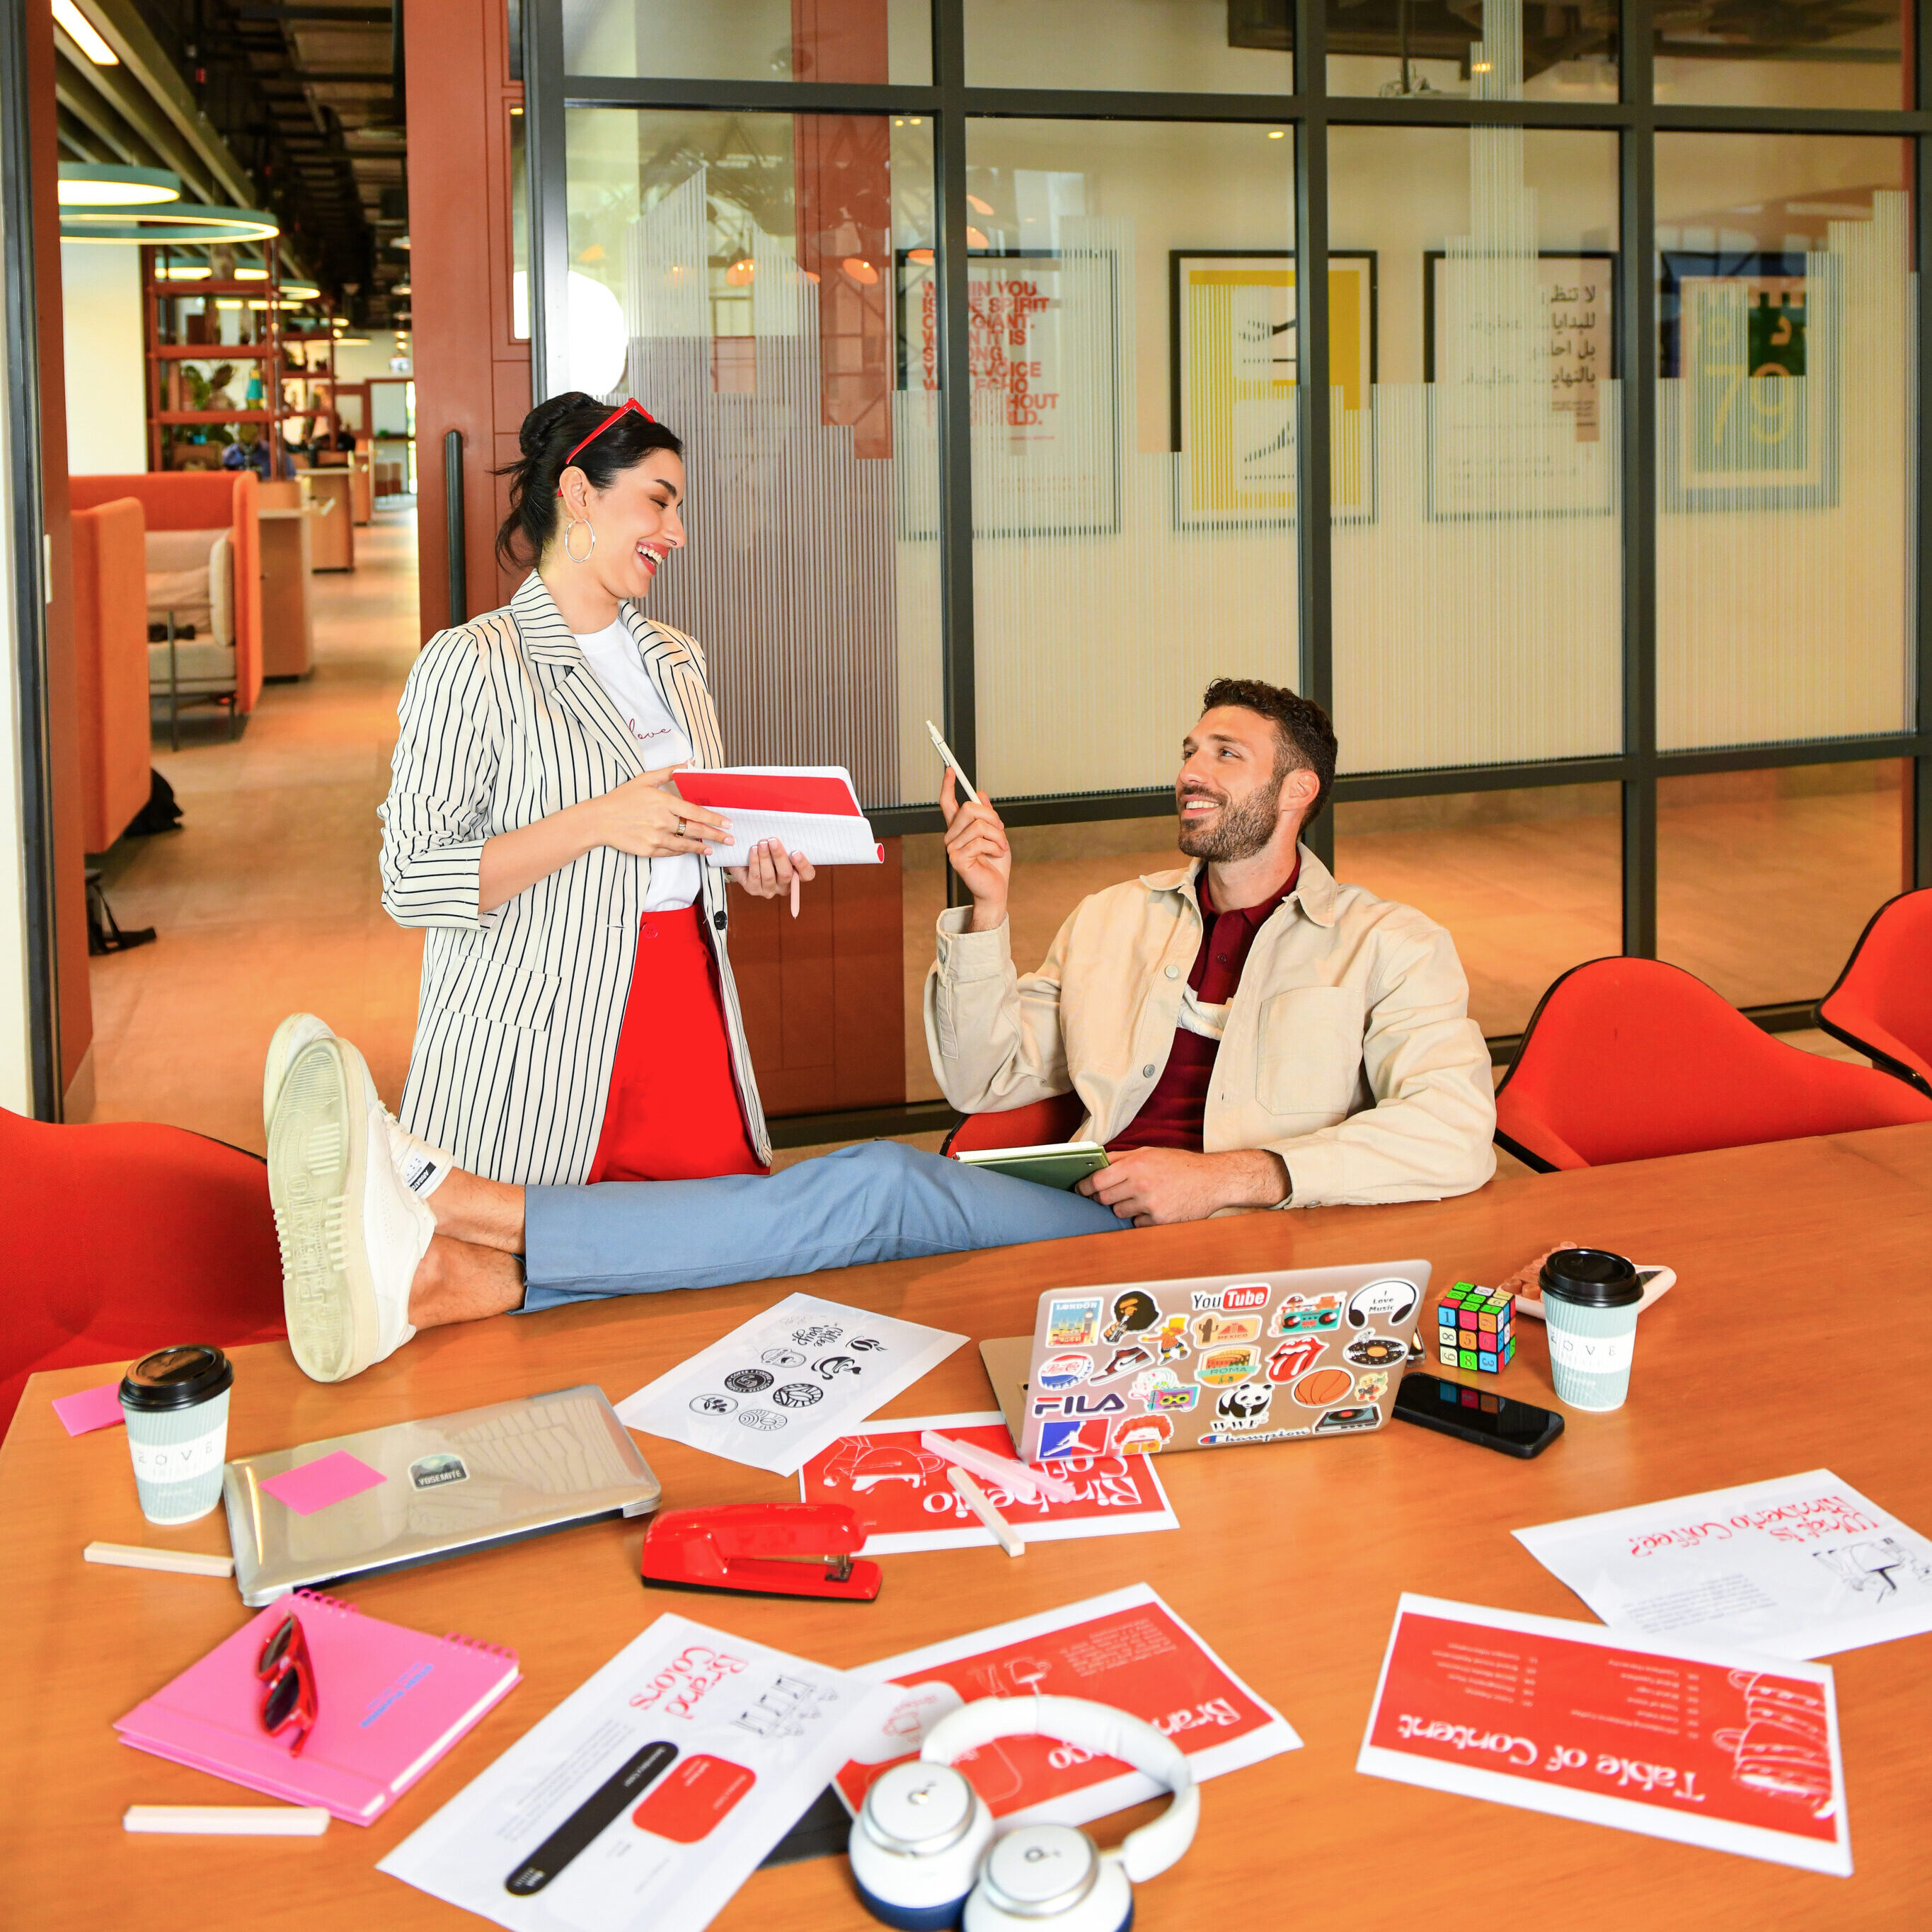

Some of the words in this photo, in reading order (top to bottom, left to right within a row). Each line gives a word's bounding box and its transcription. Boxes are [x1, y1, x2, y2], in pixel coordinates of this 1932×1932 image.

[997, 281, 1037, 297] YOU
[1546, 284, 1579, 304] تنظ
[989, 297, 1050, 313] SPIRIT
[1549, 311, 1596, 335] للبدايا
[1009, 329, 1027, 345] IS
[984, 361, 1042, 377] VOICE
[629, 718, 672, 740] love
[1193, 1288, 1267, 1309] YouTube
[1369, 1304, 1395, 1313] Music
[1210, 1366, 1248, 1375] ROMA
[1034, 1393, 1125, 1415] FILA
[1212, 1419, 1261, 1431] WWF
[1200, 1428, 1310, 1444] Champion
[418, 1469, 462, 1485] YOSEMITE
[1398, 1713, 1539, 1767] Content
[1544, 1744, 1591, 1771] of
[1594, 1753, 1706, 1803] Table
